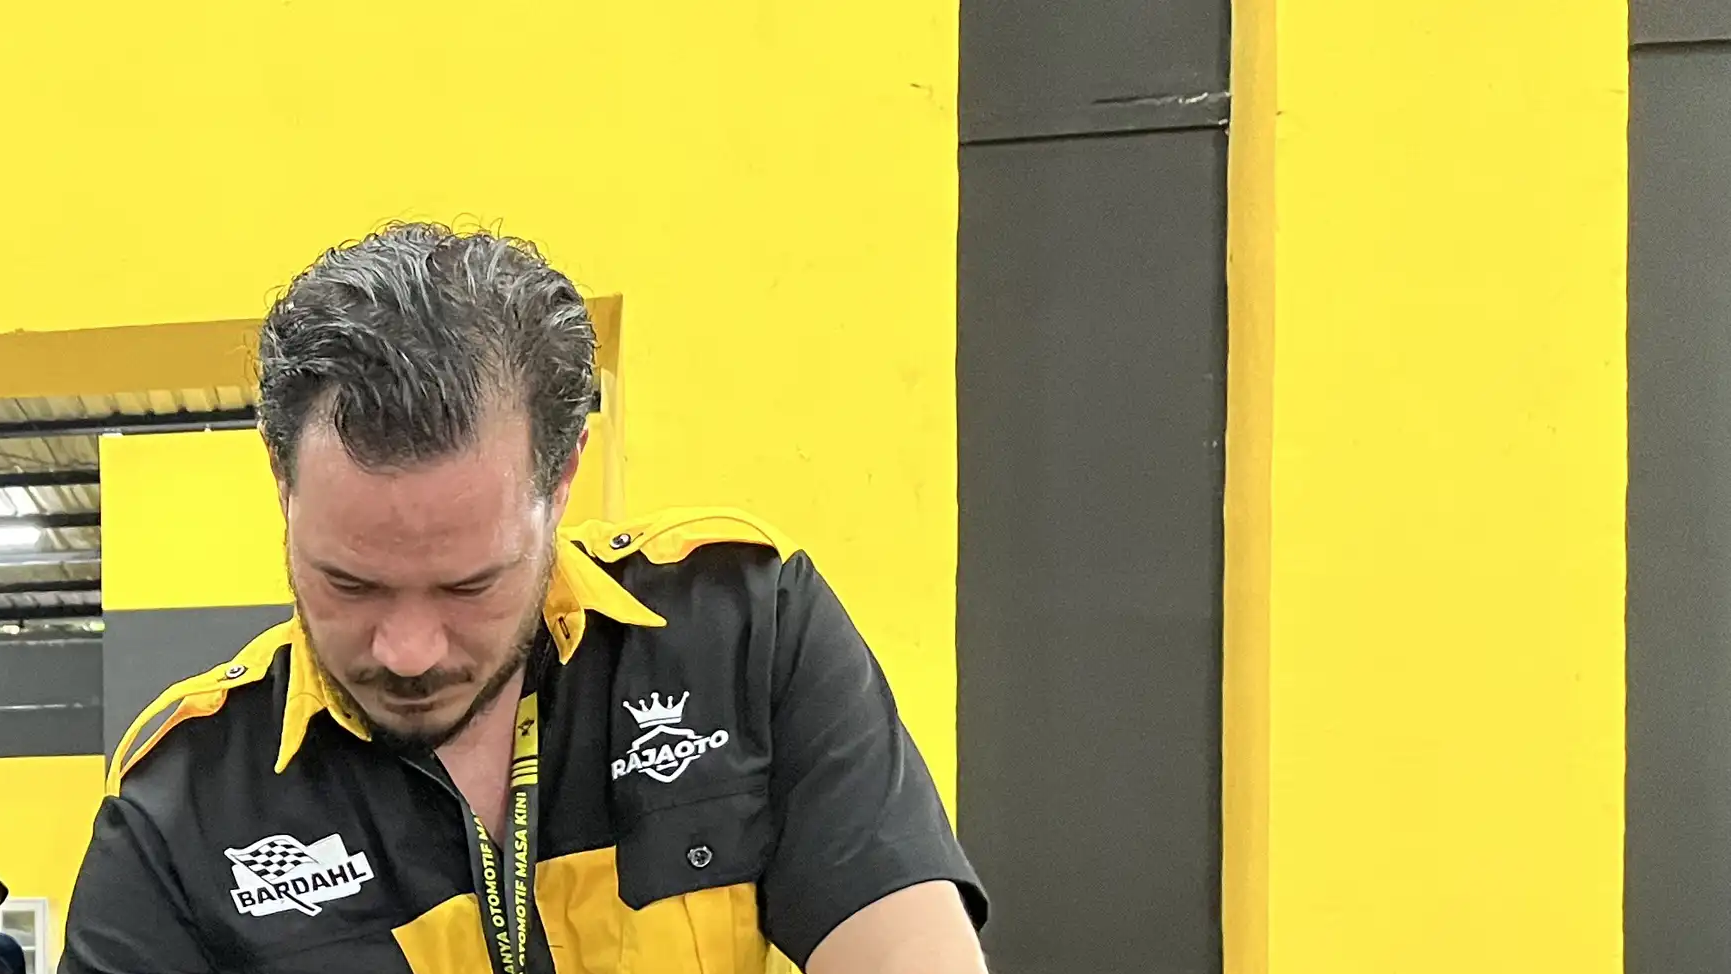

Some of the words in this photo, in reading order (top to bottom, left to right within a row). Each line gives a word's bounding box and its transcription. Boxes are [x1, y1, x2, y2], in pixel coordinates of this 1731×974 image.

[611, 730, 729, 780] RAJAOTO
[514, 792, 528, 826] KINI
[514, 829, 528, 878] MASA
[237, 862, 367, 907] BARDAHL
[479, 843, 506, 928] OTOMOTIF
